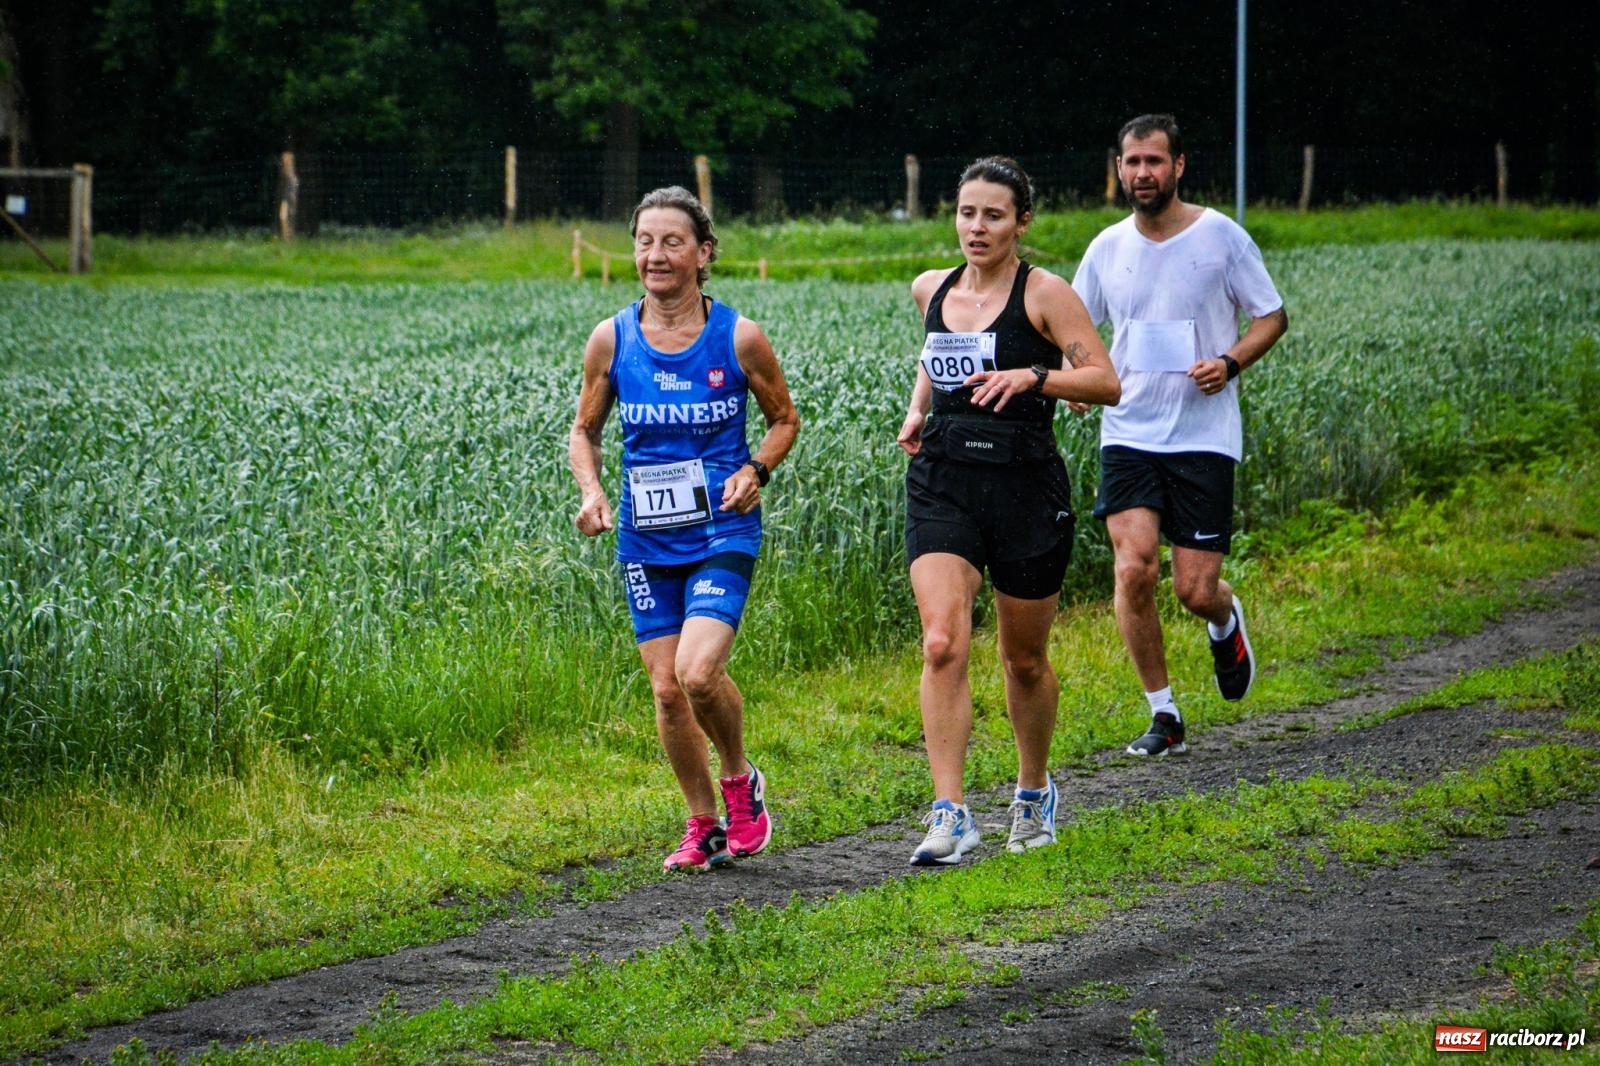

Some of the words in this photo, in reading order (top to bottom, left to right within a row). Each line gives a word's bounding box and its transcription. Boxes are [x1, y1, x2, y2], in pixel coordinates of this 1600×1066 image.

[931, 356, 975, 378] 080
[620, 396, 739, 425] RUNNERS
[965, 441, 993, 449] KIPRUN
[645, 488, 676, 511] 171
